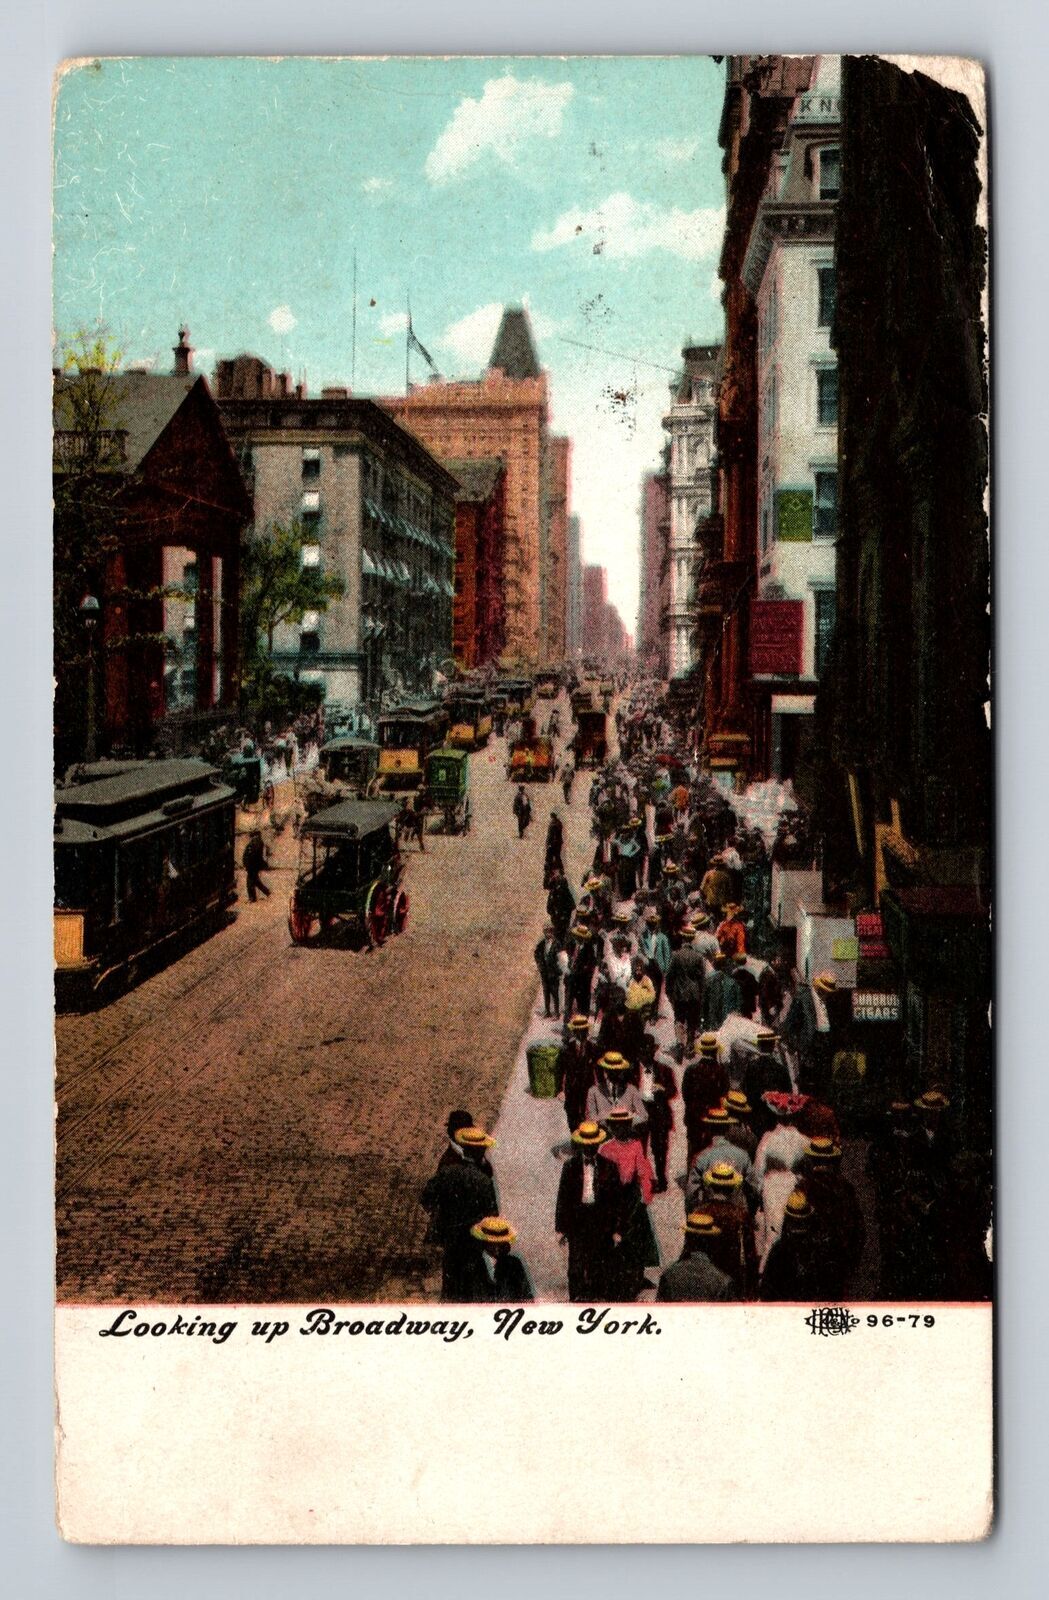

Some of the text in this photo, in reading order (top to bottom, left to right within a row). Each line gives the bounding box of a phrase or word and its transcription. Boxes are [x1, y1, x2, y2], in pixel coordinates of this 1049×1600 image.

[853, 1006, 898, 1020] CIGARS
[99, 1308, 662, 1344] Looking up Broadway, New York.
[866, 1314, 935, 1328] 96-79
